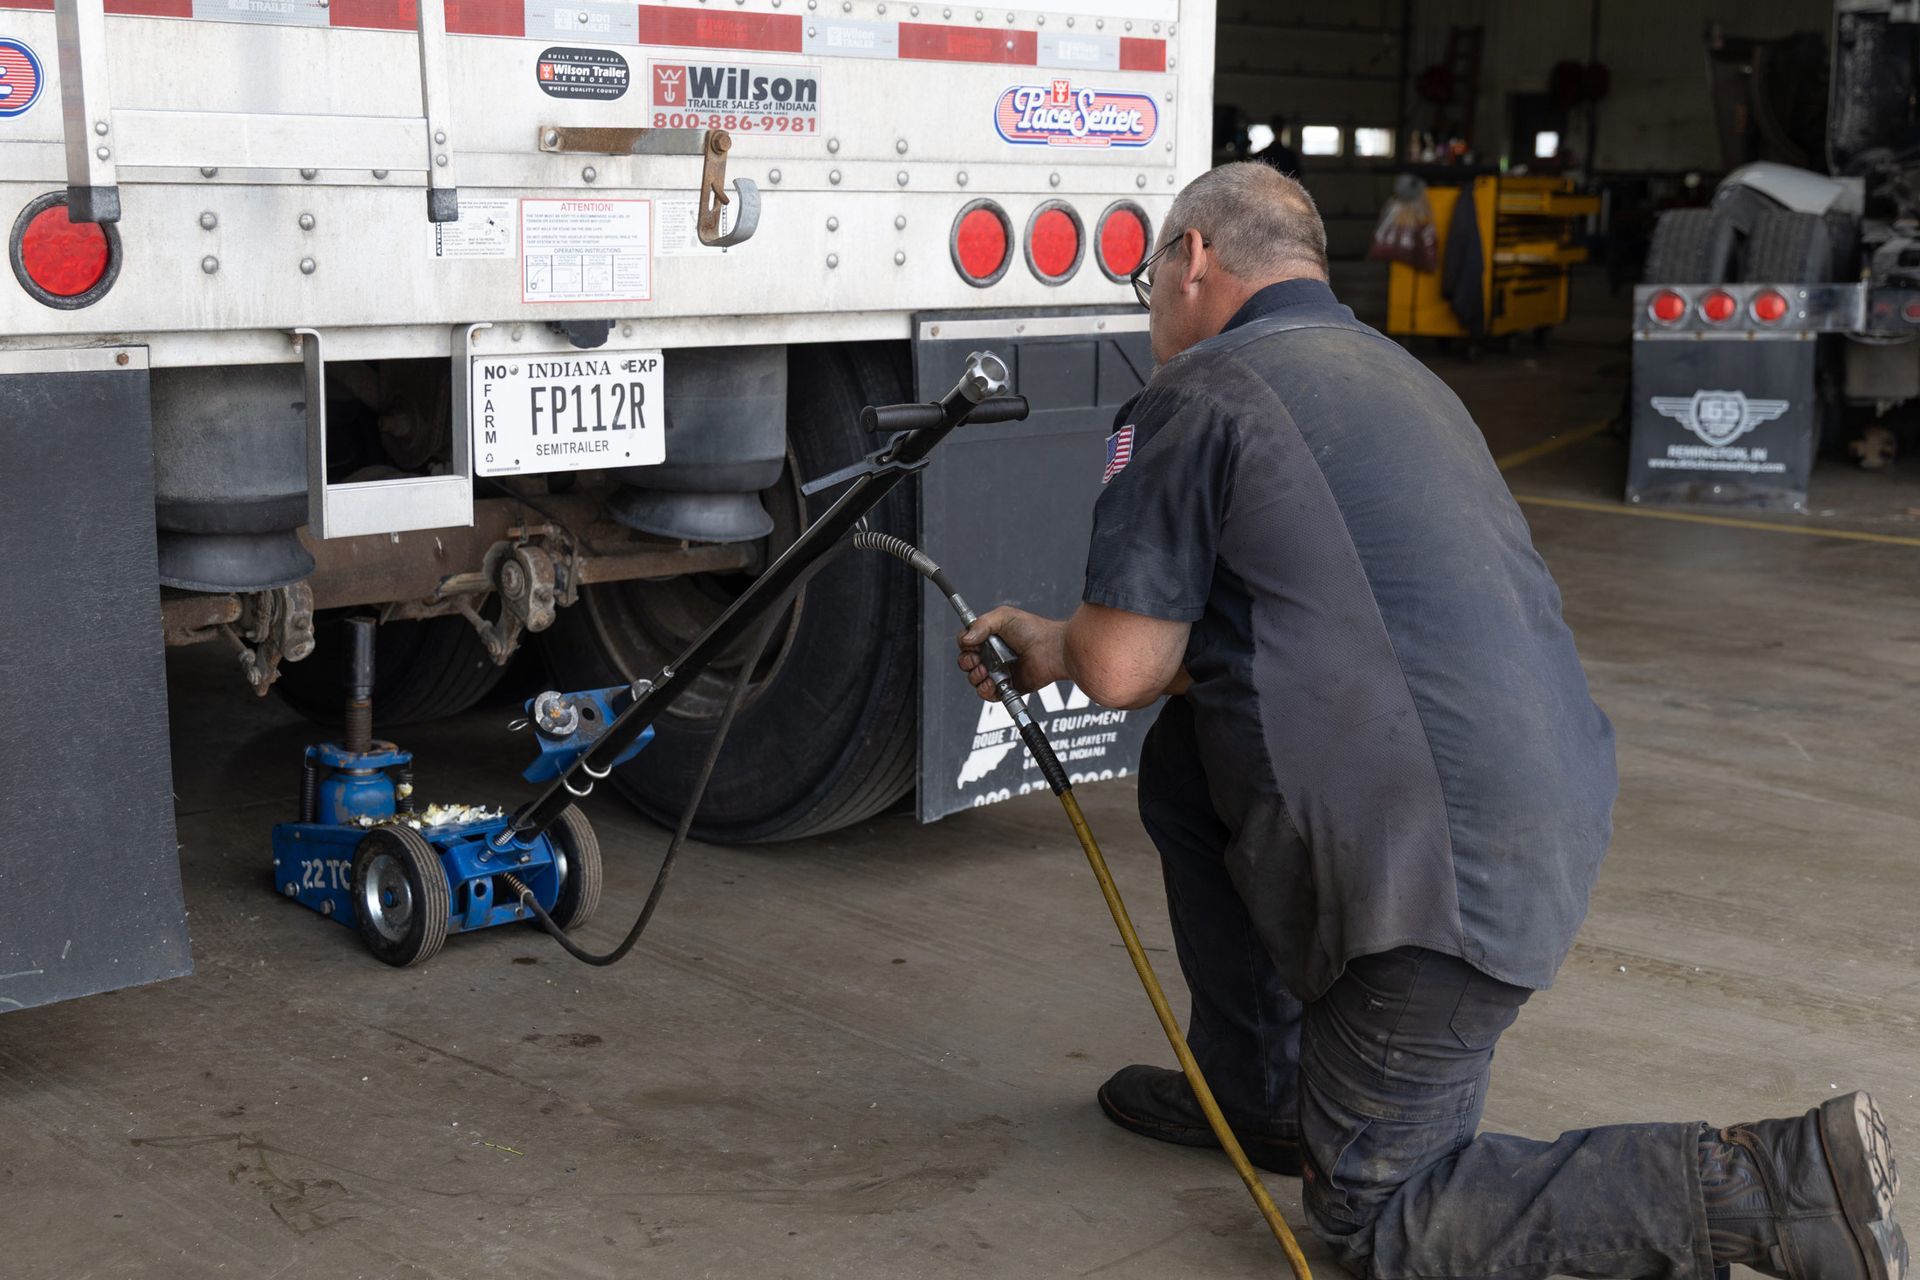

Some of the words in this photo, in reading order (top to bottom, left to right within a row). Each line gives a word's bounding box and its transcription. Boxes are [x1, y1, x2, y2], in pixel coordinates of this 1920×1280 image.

[553, 64, 590, 76] Wilson
[592, 66, 626, 78] Trailer
[688, 66, 817, 102] Wilson
[687, 99, 728, 109] TRAILER
[731, 100, 760, 110] SALES
[763, 102, 773, 111] of
[775, 102, 816, 112] INDIANA
[652, 112, 816, 133] 800-886-9981
[560, 202, 614, 212] ATTENTION!
[484, 365, 507, 380] NO
[528, 360, 611, 378] INDIANA
[628, 359, 657, 373] EXP
[530, 382, 646, 436] FP112R
[536, 440, 609, 456] SEMITRAILER
[972, 729, 1006, 750] ROWE
[1051, 710, 1128, 733] EQUIPMENT
[1071, 731, 1117, 748] LAFAYETTE
[1069, 746, 1106, 760] INDIANA
[301, 858, 326, 890] 22
